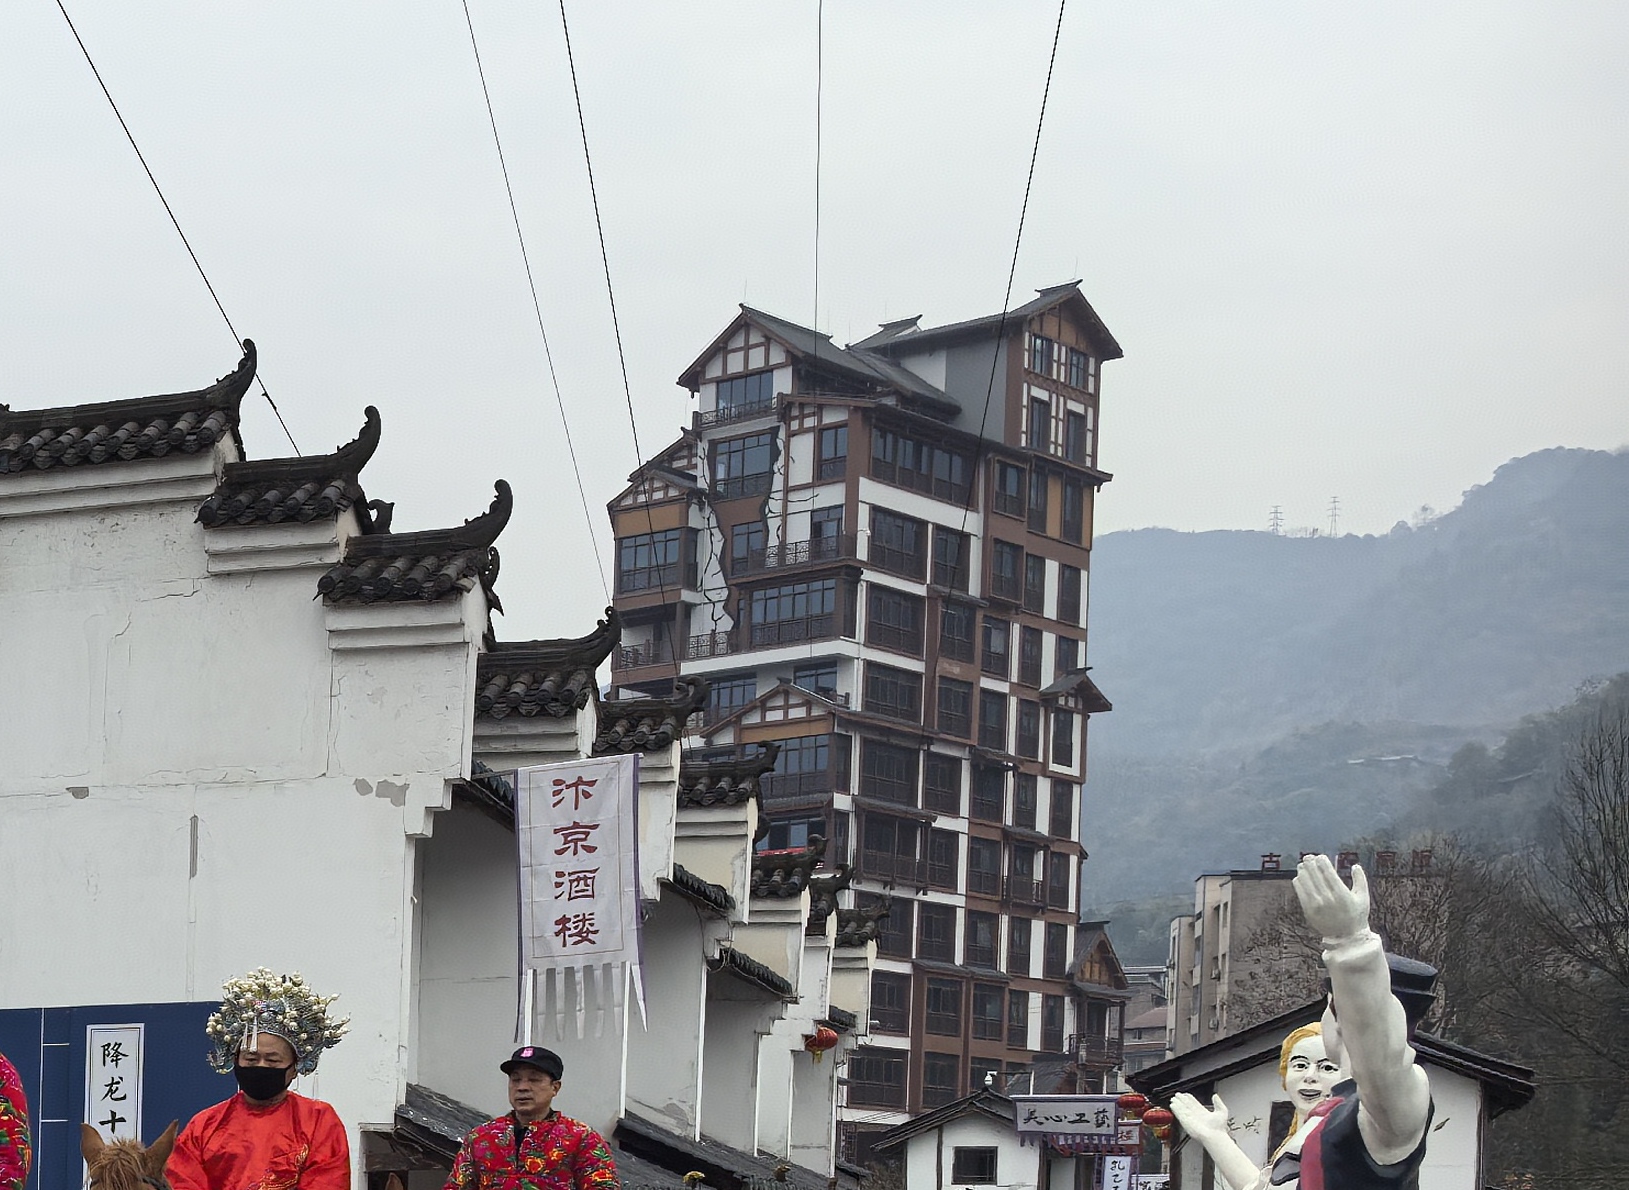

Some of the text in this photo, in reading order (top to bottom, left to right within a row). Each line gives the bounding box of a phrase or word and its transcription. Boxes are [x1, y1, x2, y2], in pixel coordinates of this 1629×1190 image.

[551, 775, 601, 948] 汴京酒楼
[98, 1041, 129, 1135] 降龙十
